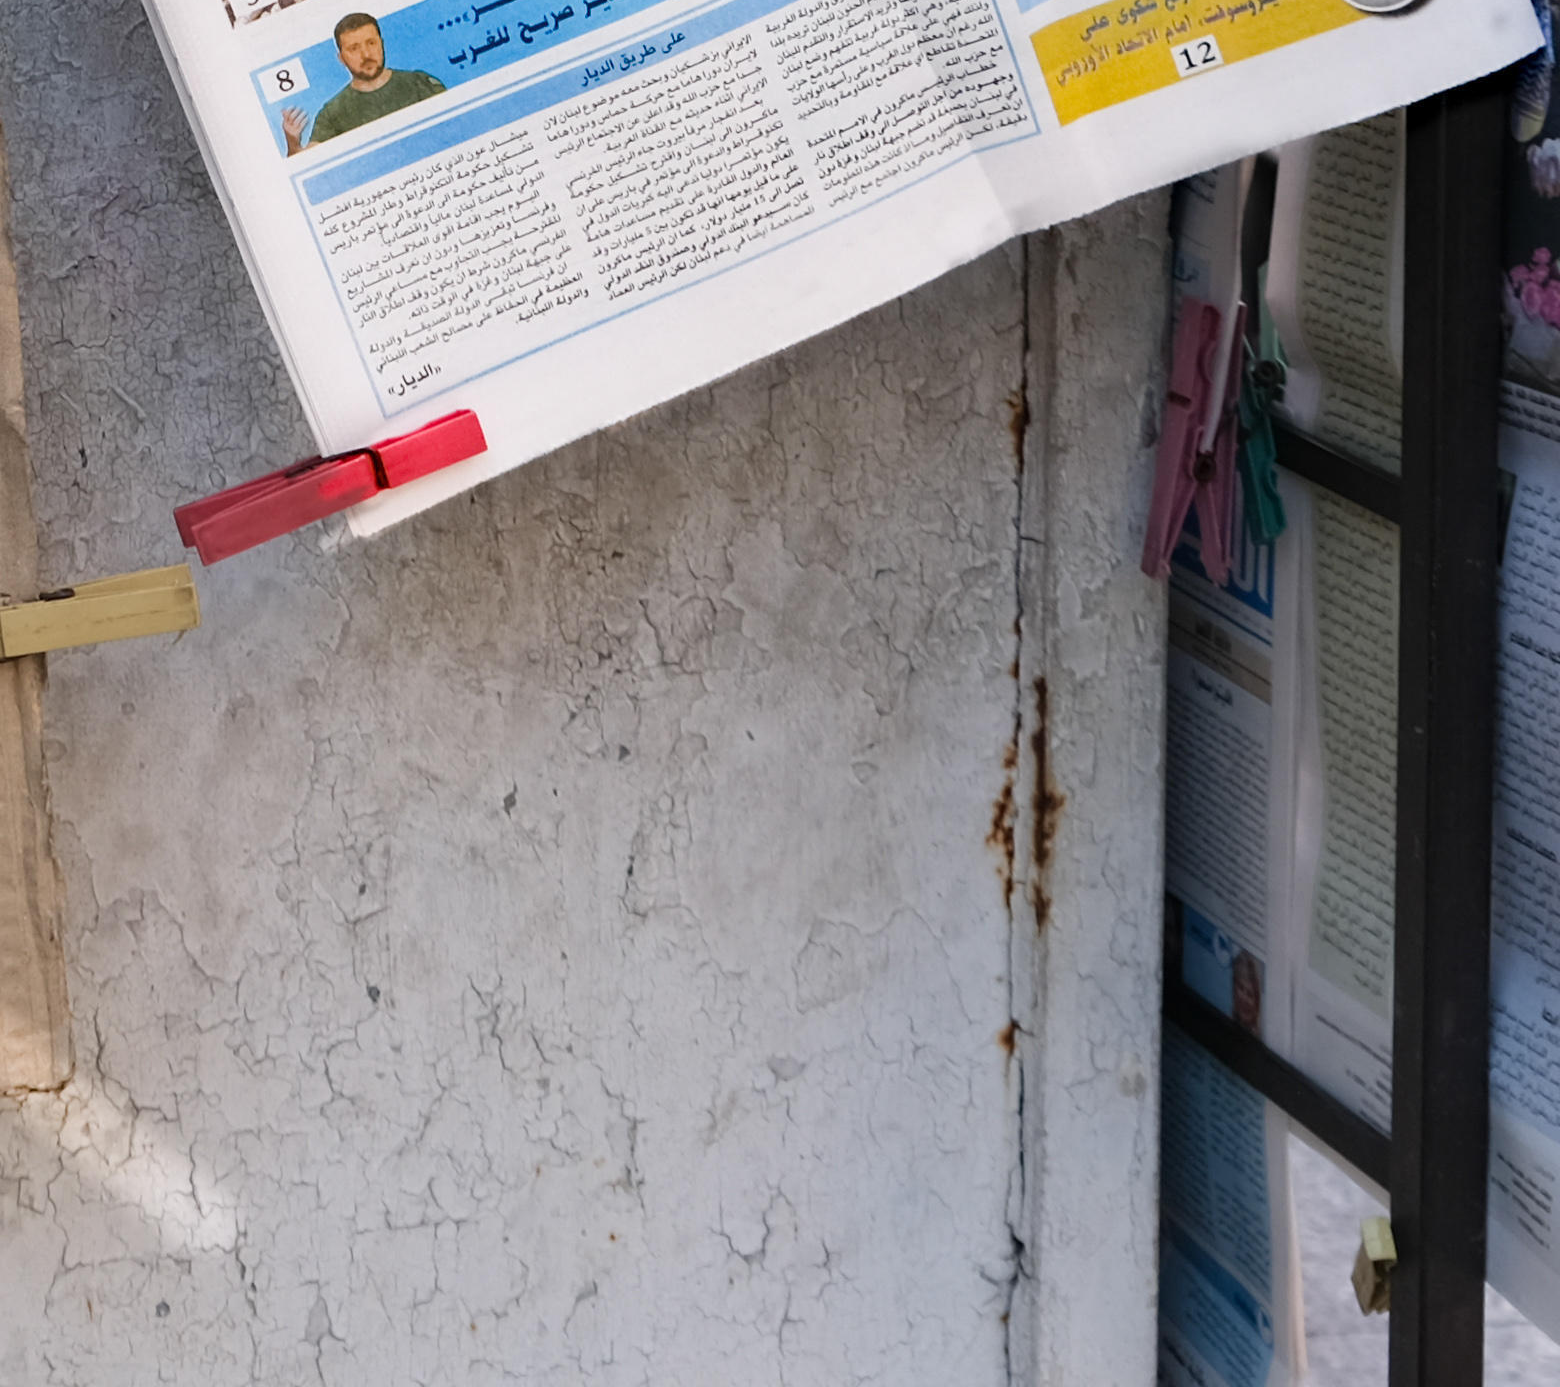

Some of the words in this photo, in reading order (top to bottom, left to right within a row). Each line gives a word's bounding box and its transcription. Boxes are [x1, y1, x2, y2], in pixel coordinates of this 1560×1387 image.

[516, 4, 575, 44] صريح
[447, 24, 511, 70] للغرب
[618, 43, 657, 72] طريق
[661, 32, 686, 55] على
[1179, 40, 1216, 70] 12
[275, 69, 295, 92] 8
[581, 58, 615, 88] الديار
